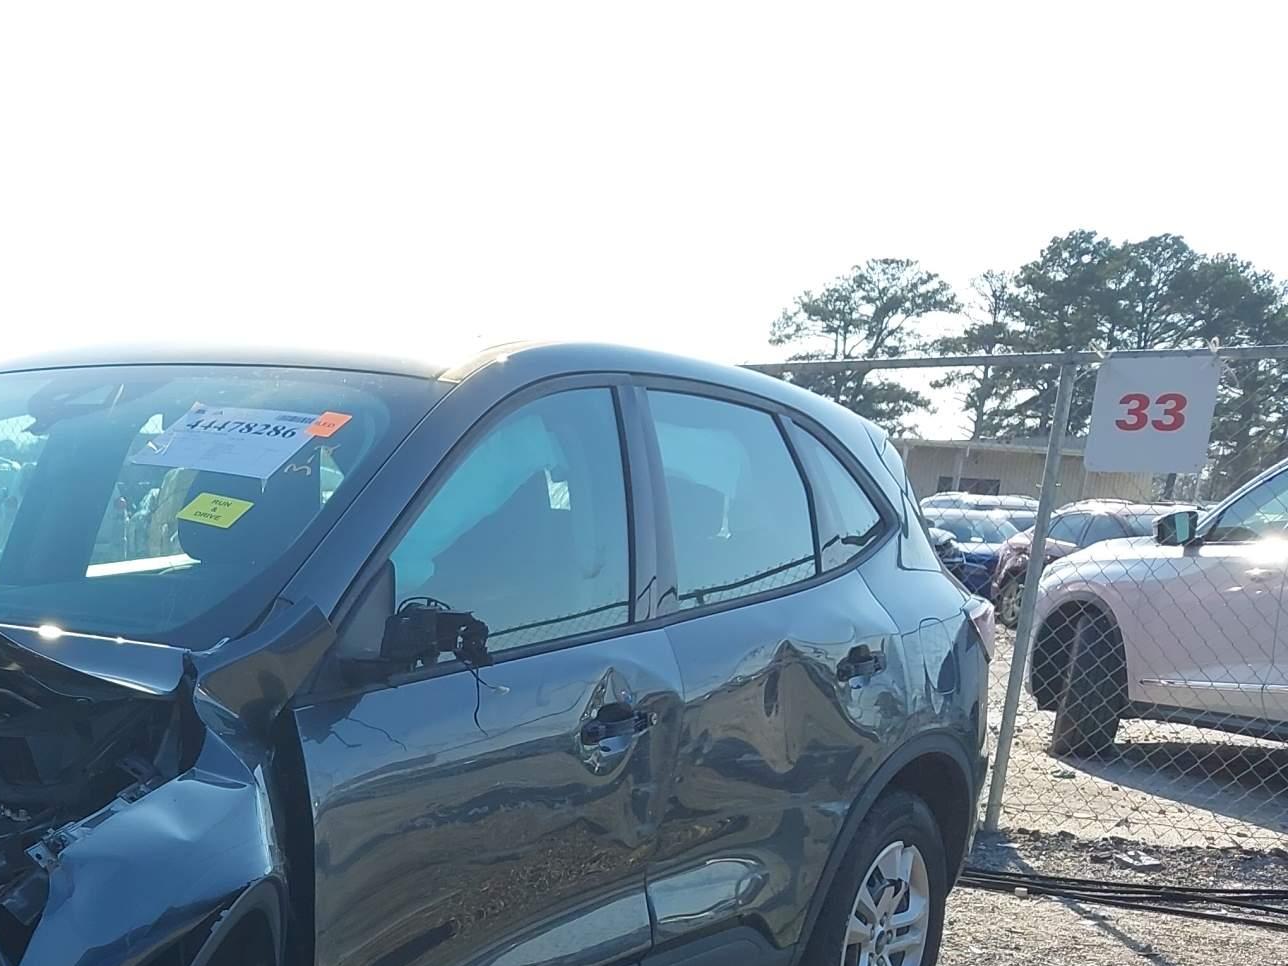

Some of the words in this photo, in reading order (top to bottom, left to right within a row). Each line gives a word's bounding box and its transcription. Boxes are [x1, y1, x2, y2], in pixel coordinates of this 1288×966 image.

[1114, 392, 1188, 432] 33
[186, 418, 298, 439] 44478286
[211, 499, 233, 508] RUN
[193, 511, 222, 521] DRIVE
